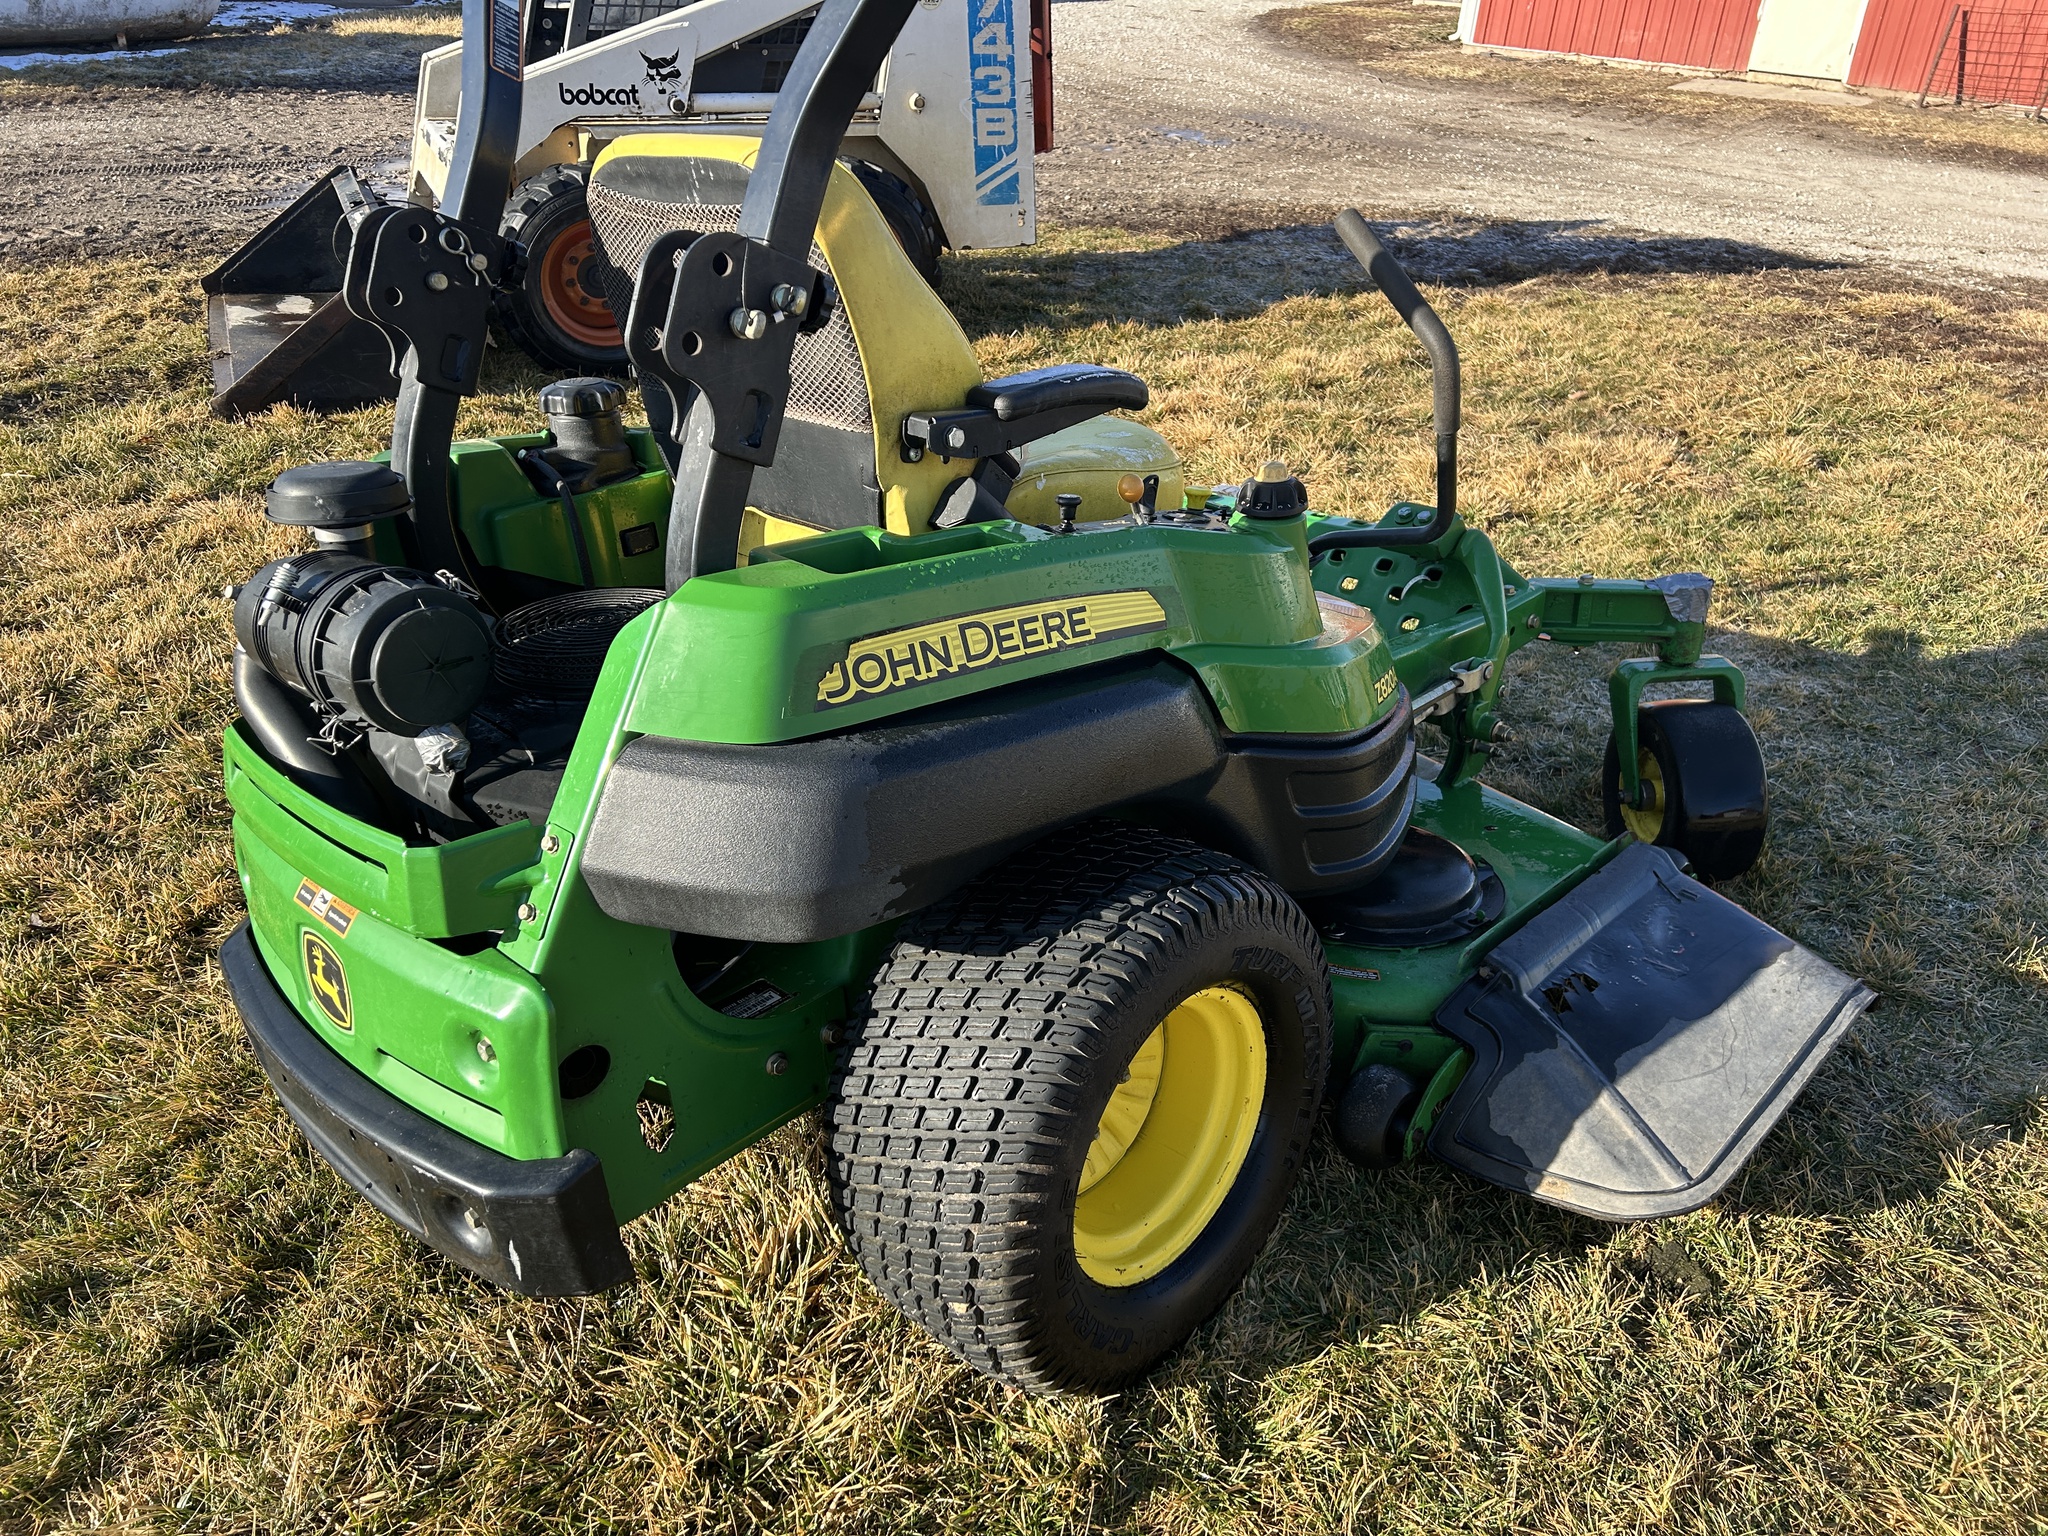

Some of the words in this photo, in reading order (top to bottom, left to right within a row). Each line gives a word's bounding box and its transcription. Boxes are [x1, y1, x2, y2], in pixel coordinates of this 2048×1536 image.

[558, 82, 640, 106] bobcat
[823, 634, 954, 702] JOHN
[956, 605, 1093, 666] DEERE
[1230, 945, 1305, 987] TURF
[1054, 1177, 1135, 1356] CARLISLE
